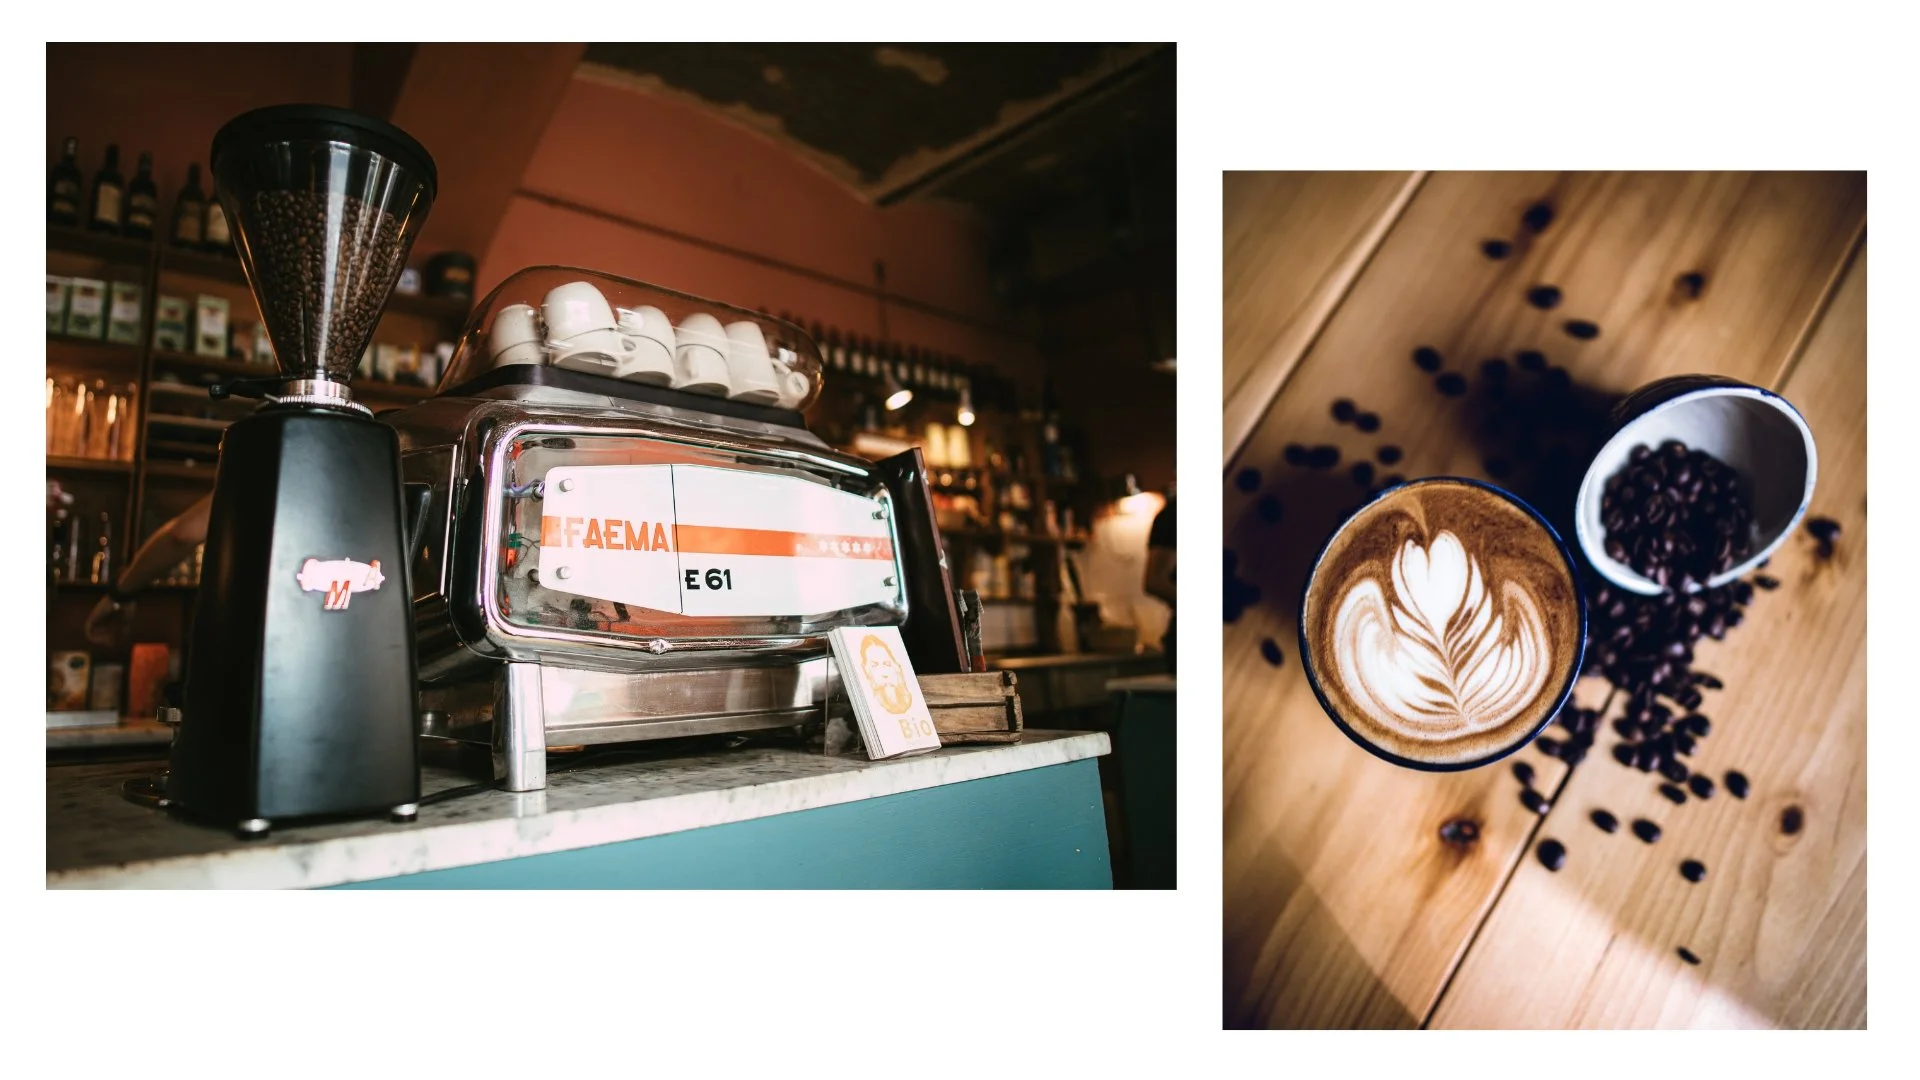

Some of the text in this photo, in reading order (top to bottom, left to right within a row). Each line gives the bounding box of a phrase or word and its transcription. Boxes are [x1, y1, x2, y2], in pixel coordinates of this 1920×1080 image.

[562, 516, 669, 552] FAEMA
[685, 567, 732, 590] E 61
